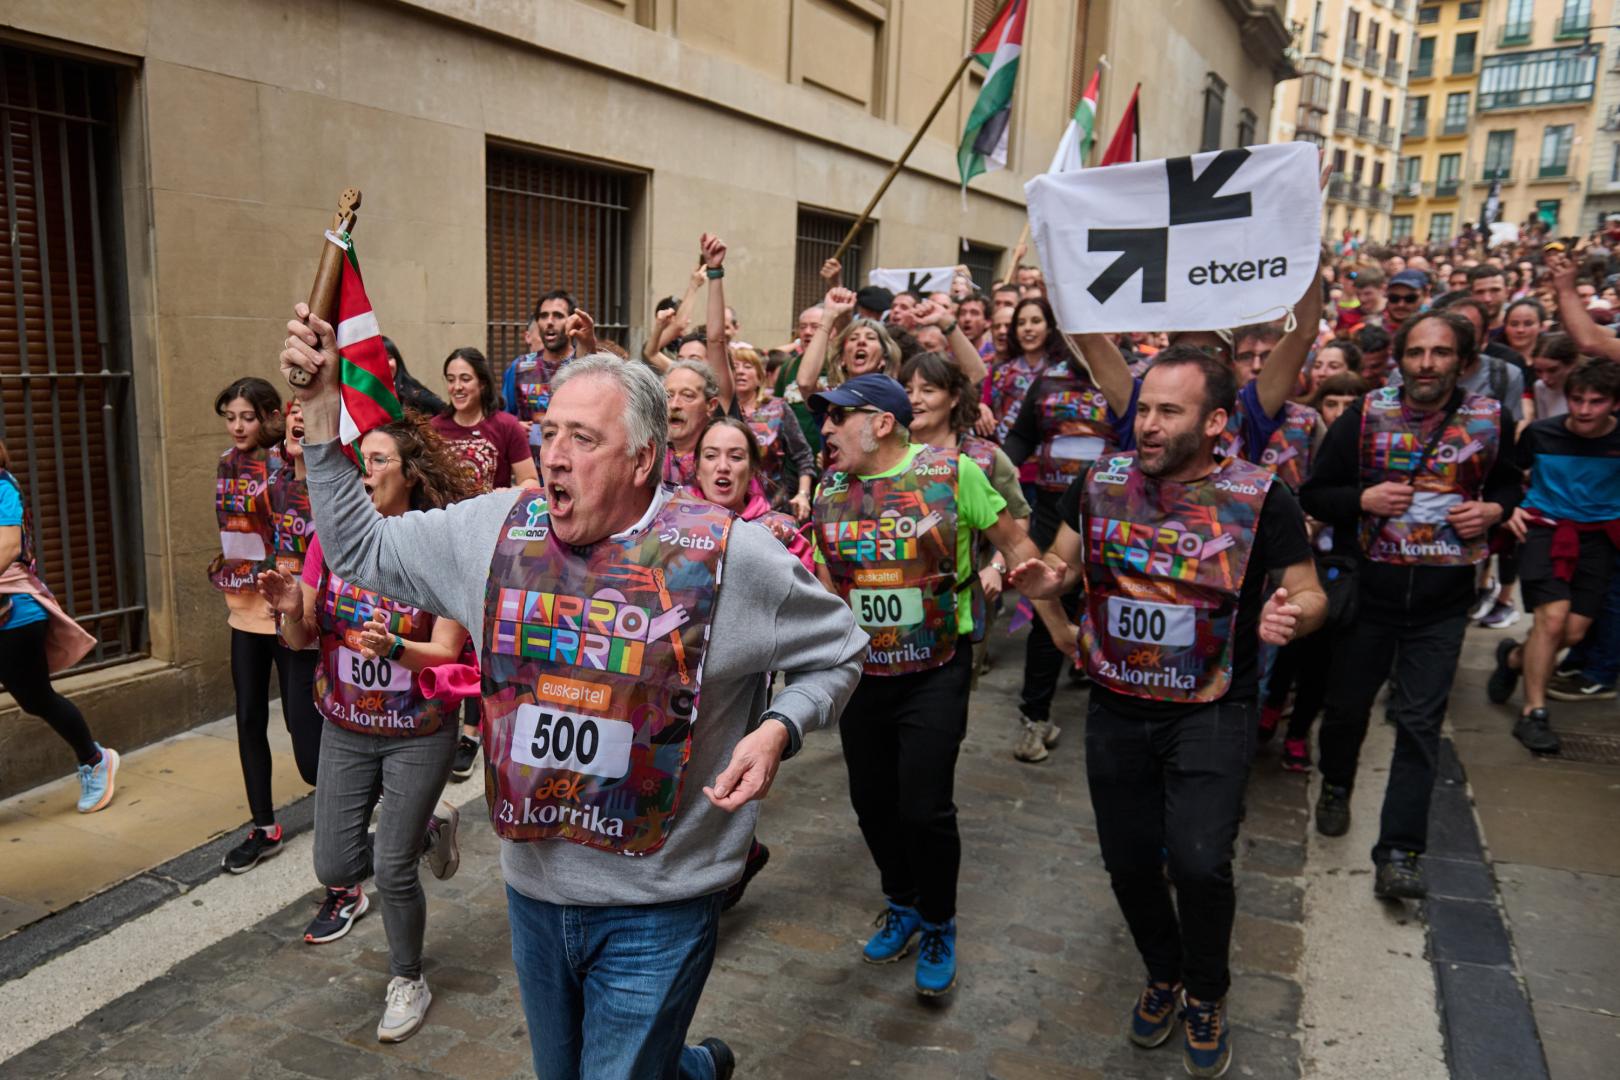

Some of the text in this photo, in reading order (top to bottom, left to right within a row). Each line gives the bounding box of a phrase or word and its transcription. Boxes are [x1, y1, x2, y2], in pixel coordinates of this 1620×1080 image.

[1188, 256, 1288, 286] etxera
[927, 464, 951, 476] eitb
[1230, 483, 1259, 496] eitb
[679, 532, 715, 551] eitb
[498, 587, 651, 642] HARRO
[860, 594, 902, 623] 500
[1118, 605, 1166, 641] 500
[872, 628, 901, 648] aek
[866, 643, 932, 666] .korrika
[1127, 648, 1163, 668] aek
[351, 656, 392, 688] 500
[357, 690, 385, 711] aek
[541, 680, 605, 705] euskaltel
[531, 712, 600, 765] 500
[535, 774, 586, 803] aek
